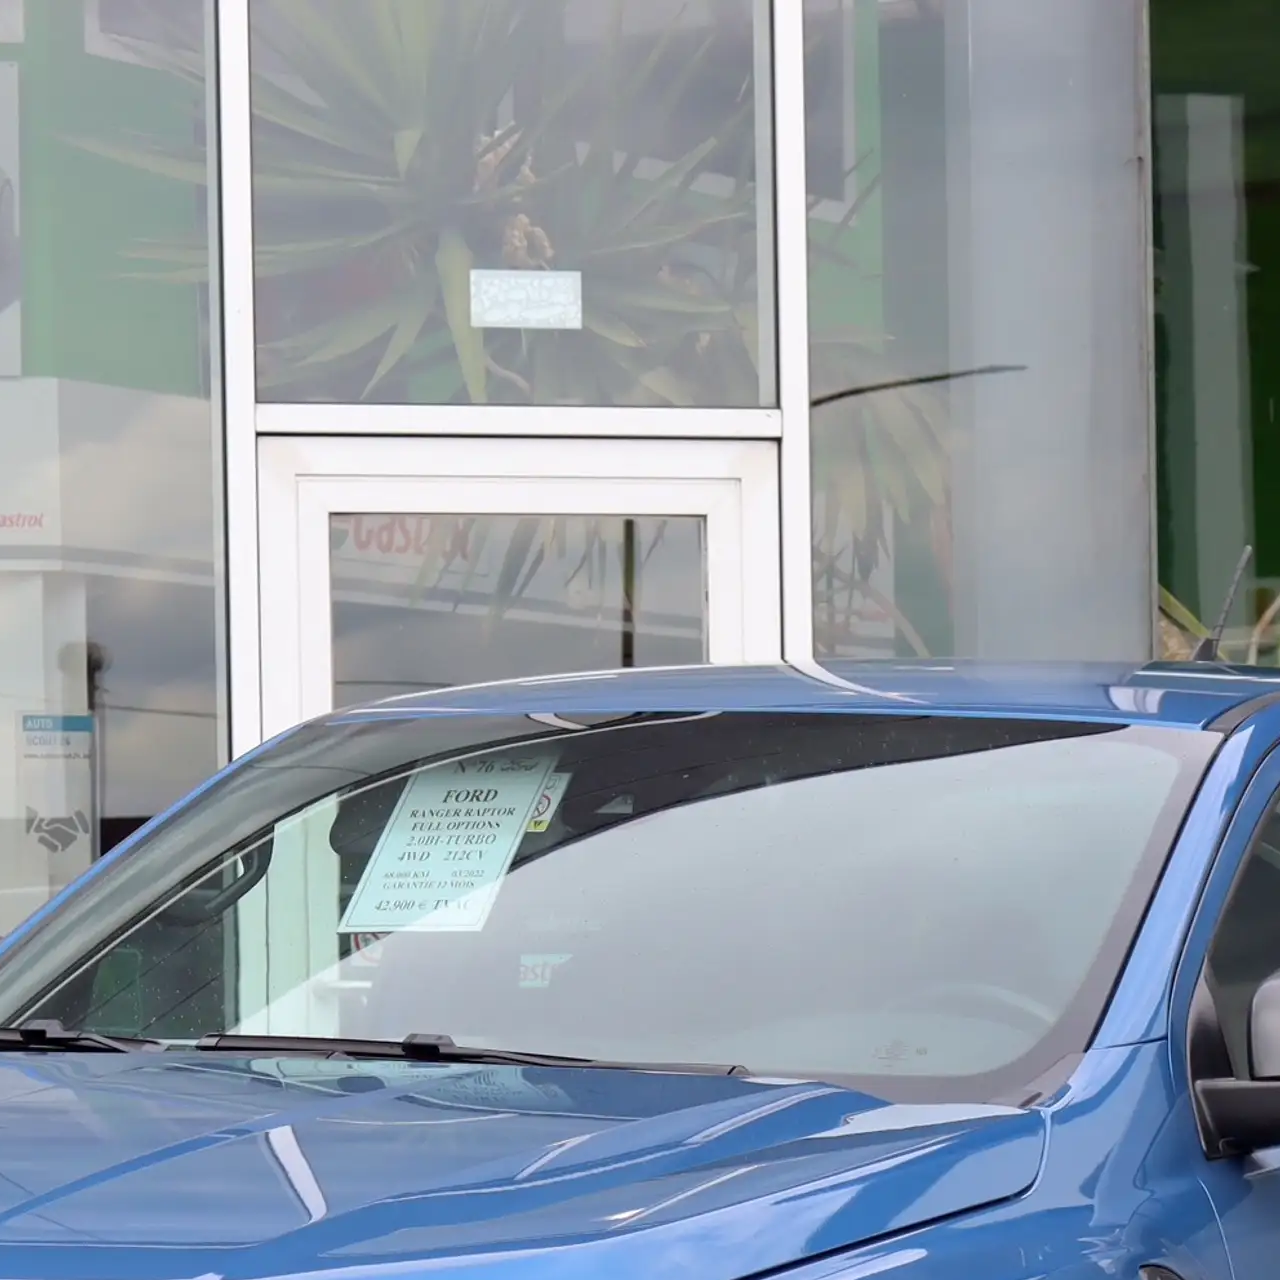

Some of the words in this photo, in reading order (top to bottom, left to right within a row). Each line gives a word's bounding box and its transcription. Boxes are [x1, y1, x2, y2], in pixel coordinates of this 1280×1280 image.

[442, 789, 498, 804] FORD
[410, 809, 461, 818] RANGER
[464, 807, 516, 817] RAPTOR
[411, 822, 443, 831] FULL
[446, 821, 500, 831] OPTIONS
[398, 851, 430, 861] 4WD
